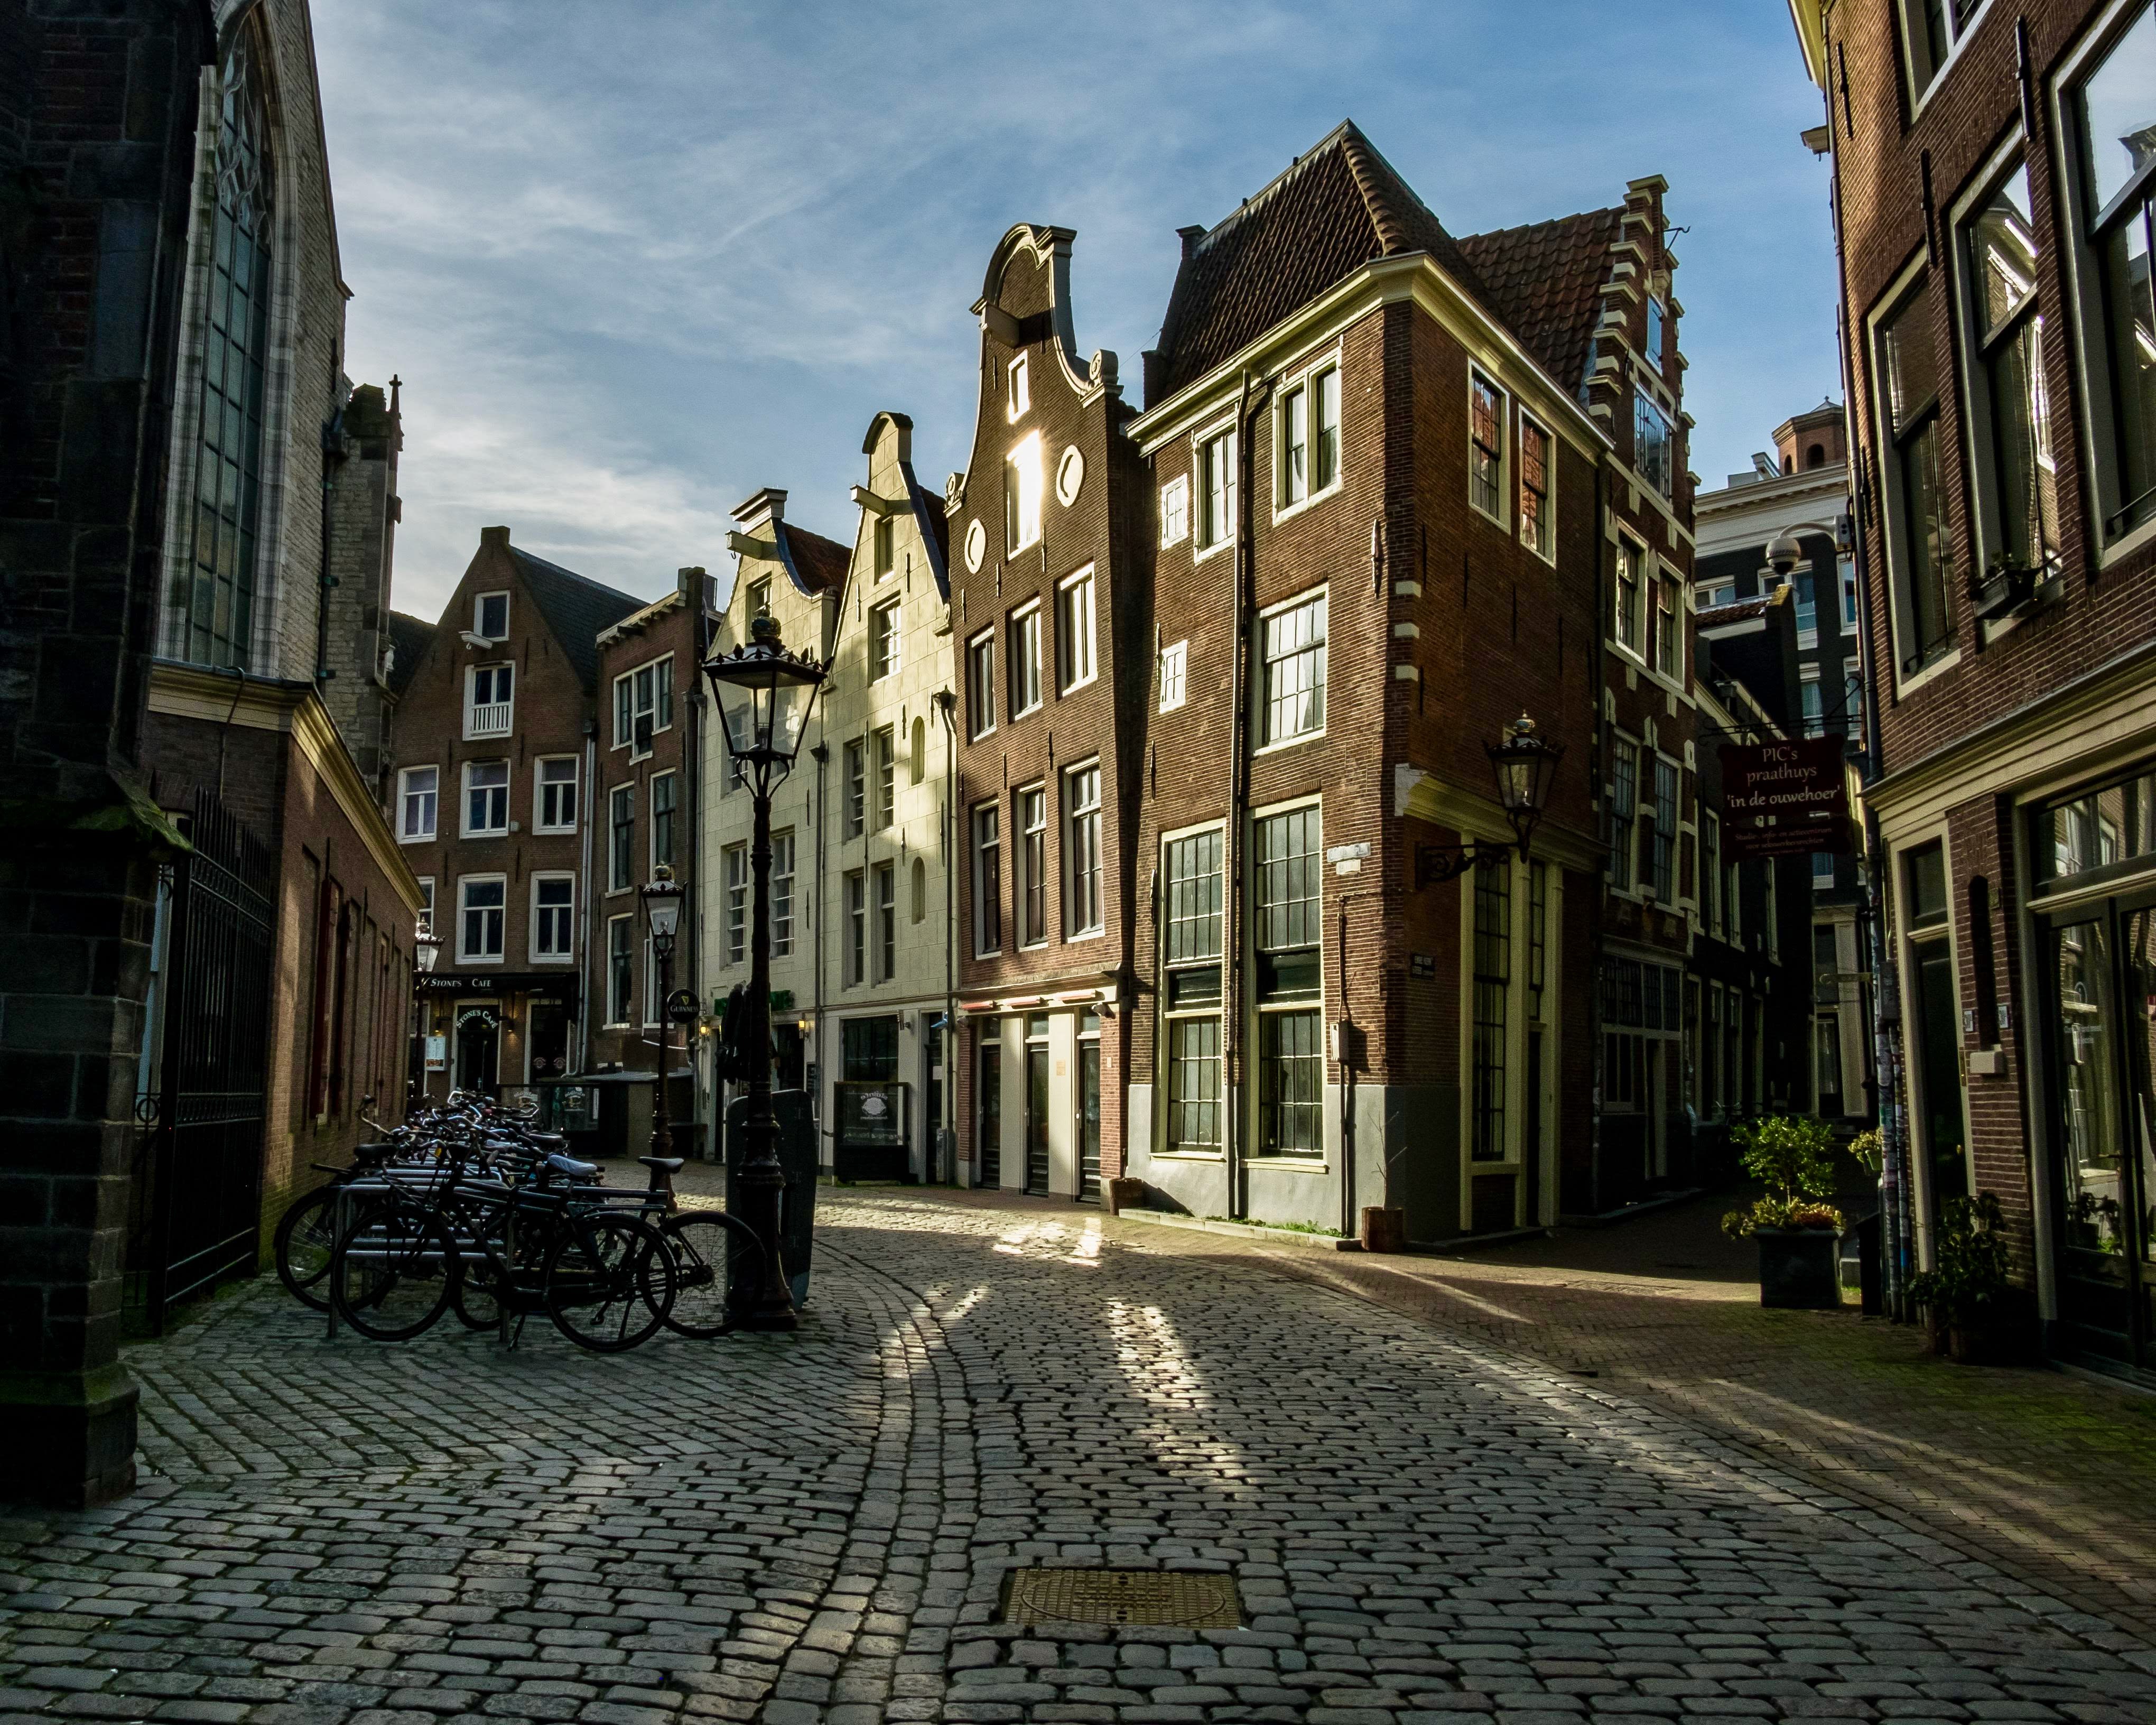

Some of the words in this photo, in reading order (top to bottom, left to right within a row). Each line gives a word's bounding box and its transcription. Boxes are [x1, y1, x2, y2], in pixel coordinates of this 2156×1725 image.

[1762, 746, 1799, 762] PIC's
[1746, 763, 1818, 787] praathuys
[1750, 790, 1767, 806] de
[1770, 784, 1841, 804] ouwehoer'
